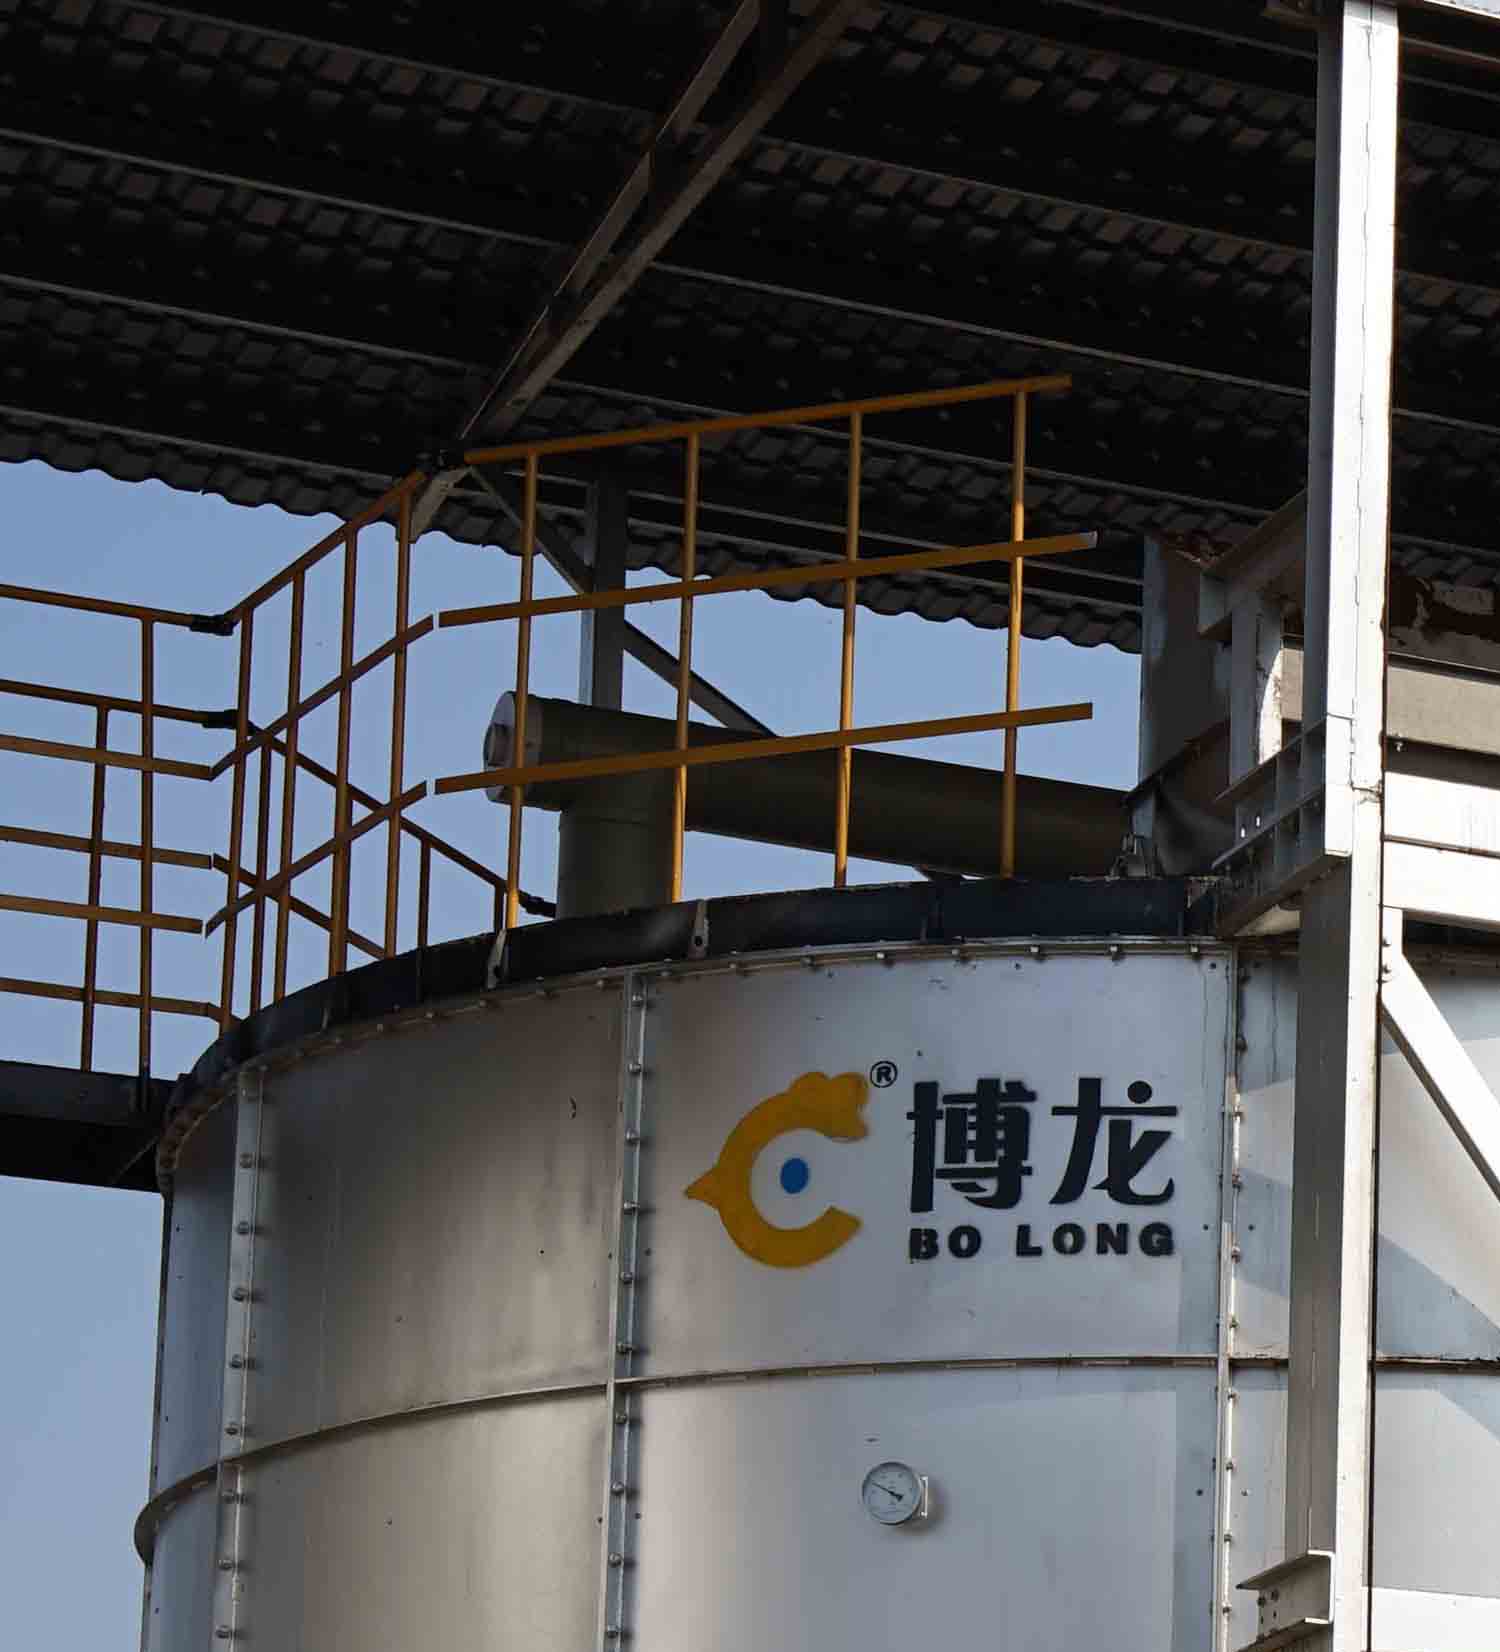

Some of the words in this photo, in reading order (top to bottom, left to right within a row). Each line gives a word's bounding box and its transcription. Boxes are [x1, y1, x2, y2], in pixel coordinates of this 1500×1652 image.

[906, 1077, 1178, 1213] 博龙
[909, 1225, 982, 1261] BO
[1015, 1222, 1175, 1257] LONG
